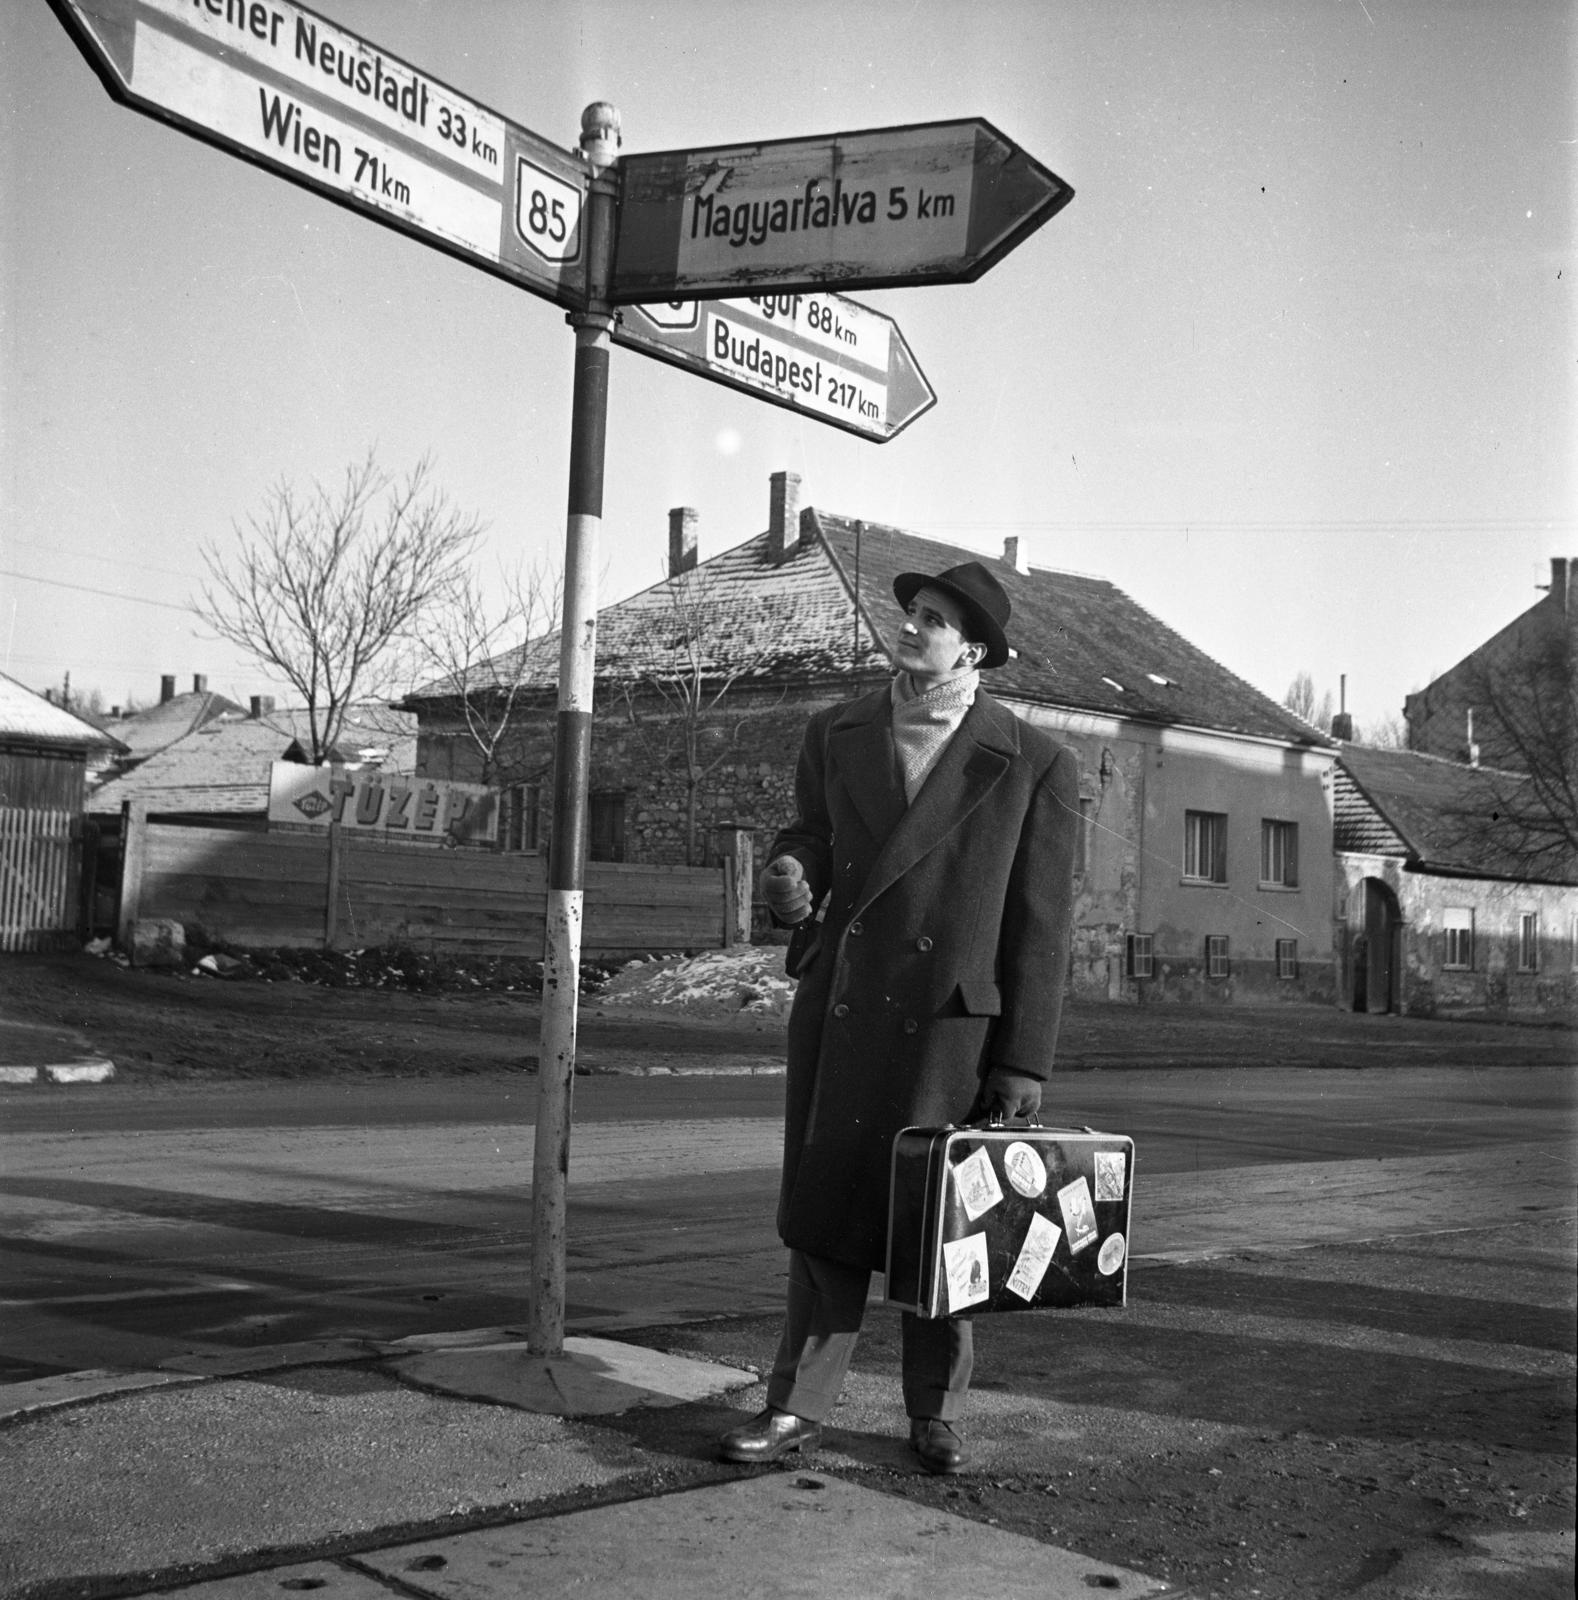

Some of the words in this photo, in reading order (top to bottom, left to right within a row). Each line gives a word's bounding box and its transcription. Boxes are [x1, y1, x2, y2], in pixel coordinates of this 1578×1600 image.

[295, 16, 429, 127] Neustadt
[437, 106, 467, 148] 33
[472, 127, 498, 165] km
[259, 87, 341, 174] Wien
[529, 189, 566, 243] 85
[691, 179, 877, 247] Magyarfalva
[886, 186, 908, 221] 5
[917, 188, 956, 219] km
[807, 301, 832, 334] 88
[834, 316, 857, 346] km
[714, 319, 822, 395] Budapest
[827, 378, 856, 409] 217
[858, 390, 879, 419] km
[329, 775, 469, 832] TÜZÉP
